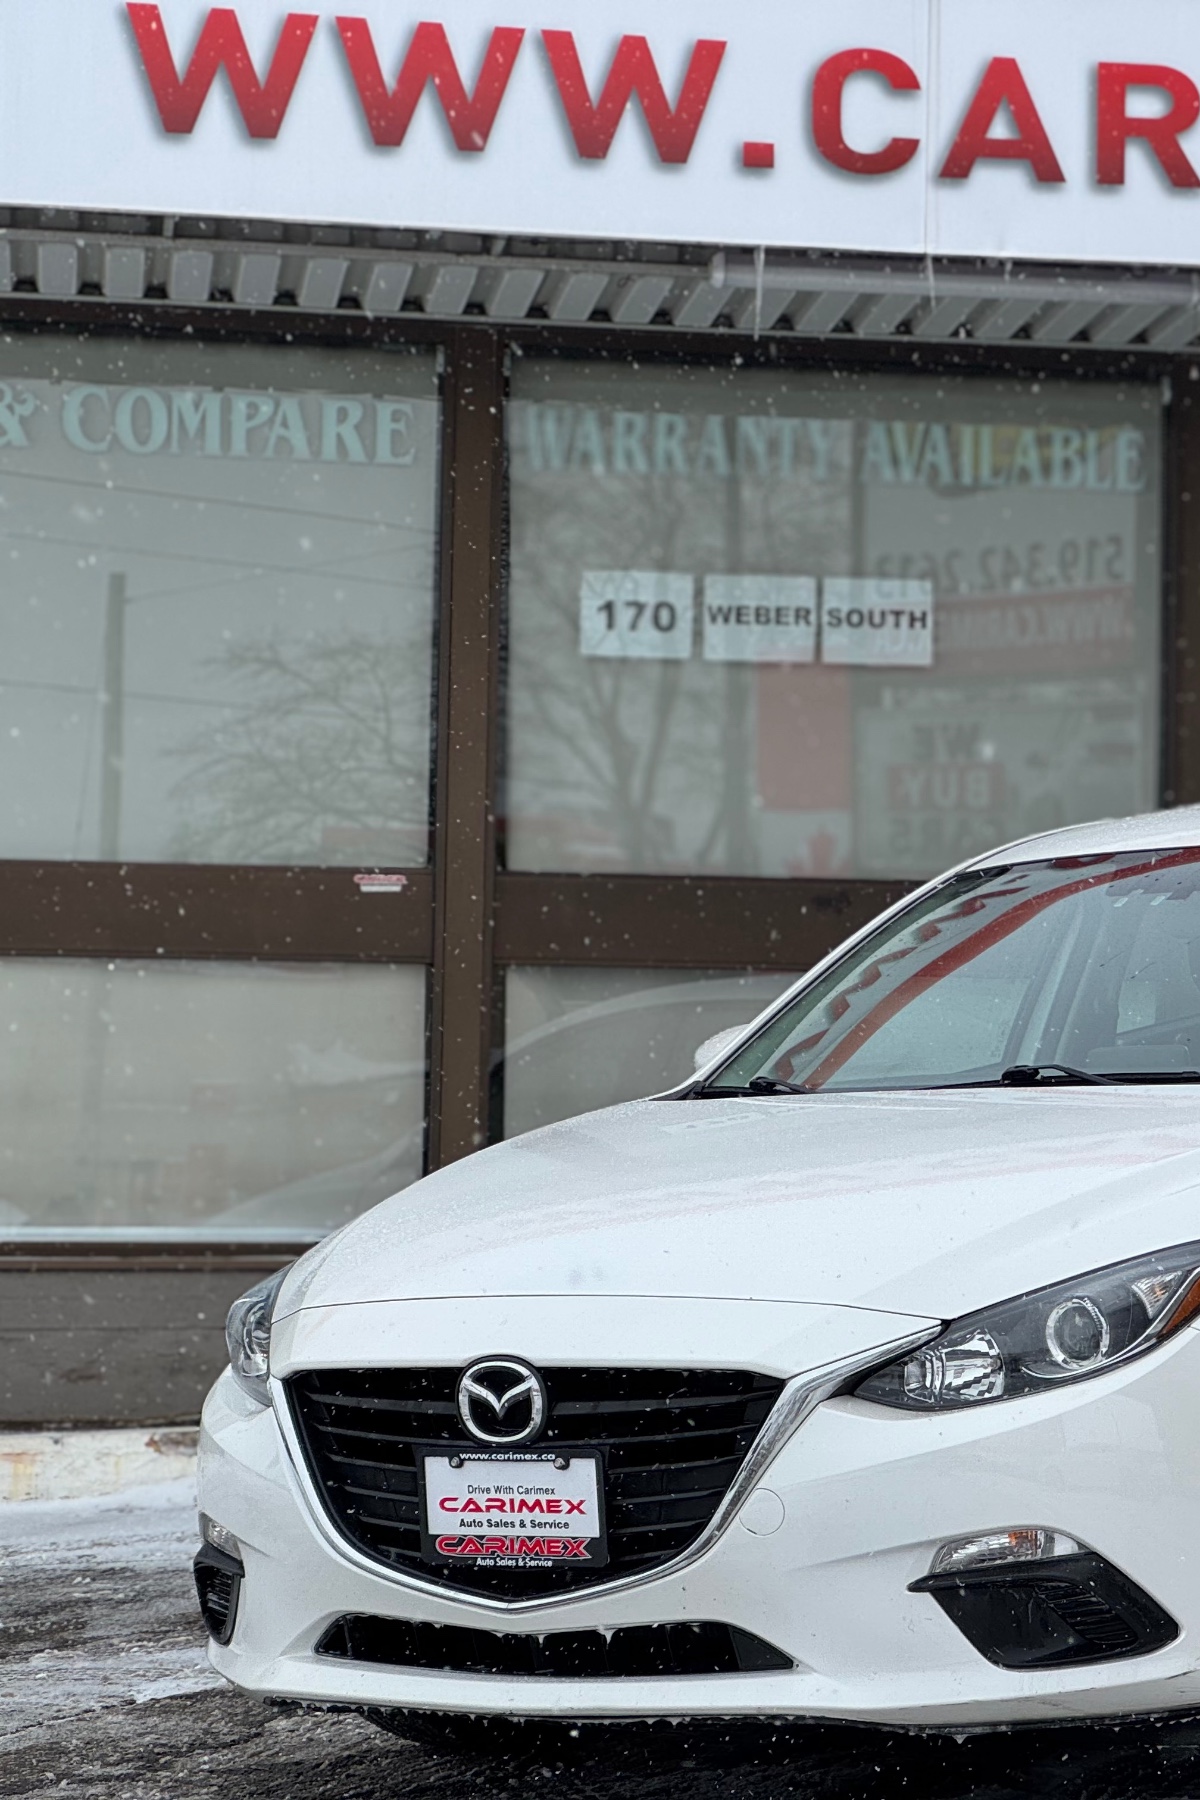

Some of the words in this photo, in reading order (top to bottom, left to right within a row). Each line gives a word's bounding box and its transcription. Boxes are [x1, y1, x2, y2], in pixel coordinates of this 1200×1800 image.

[61, 385, 416, 466] COMPARE
[523, 406, 838, 479] WARRANTY
[862, 424, 1146, 491] AVAILABLE
[598, 602, 677, 633] 170
[707, 603, 813, 628] WEBER
[826, 606, 929, 632] SOUTH
[459, 1452, 556, 1461] www.carimex.ca
[467, 1484, 491, 1495] Drive
[493, 1484, 515, 1495] With
[516, 1485, 556, 1496] Carimex
[438, 1497, 587, 1515] CARIMEX
[459, 1518, 484, 1529] Auto
[486, 1519, 516, 1529] Sales
[518, 1519, 527, 1529] &
[530, 1519, 570, 1530] Service
[435, 1534, 592, 1558] CARIMEX
[476, 1557, 495, 1567] Auto
[496, 1557, 517, 1567] Sales
[518, 1557, 525, 1567] &
[525, 1557, 553, 1568] Service
